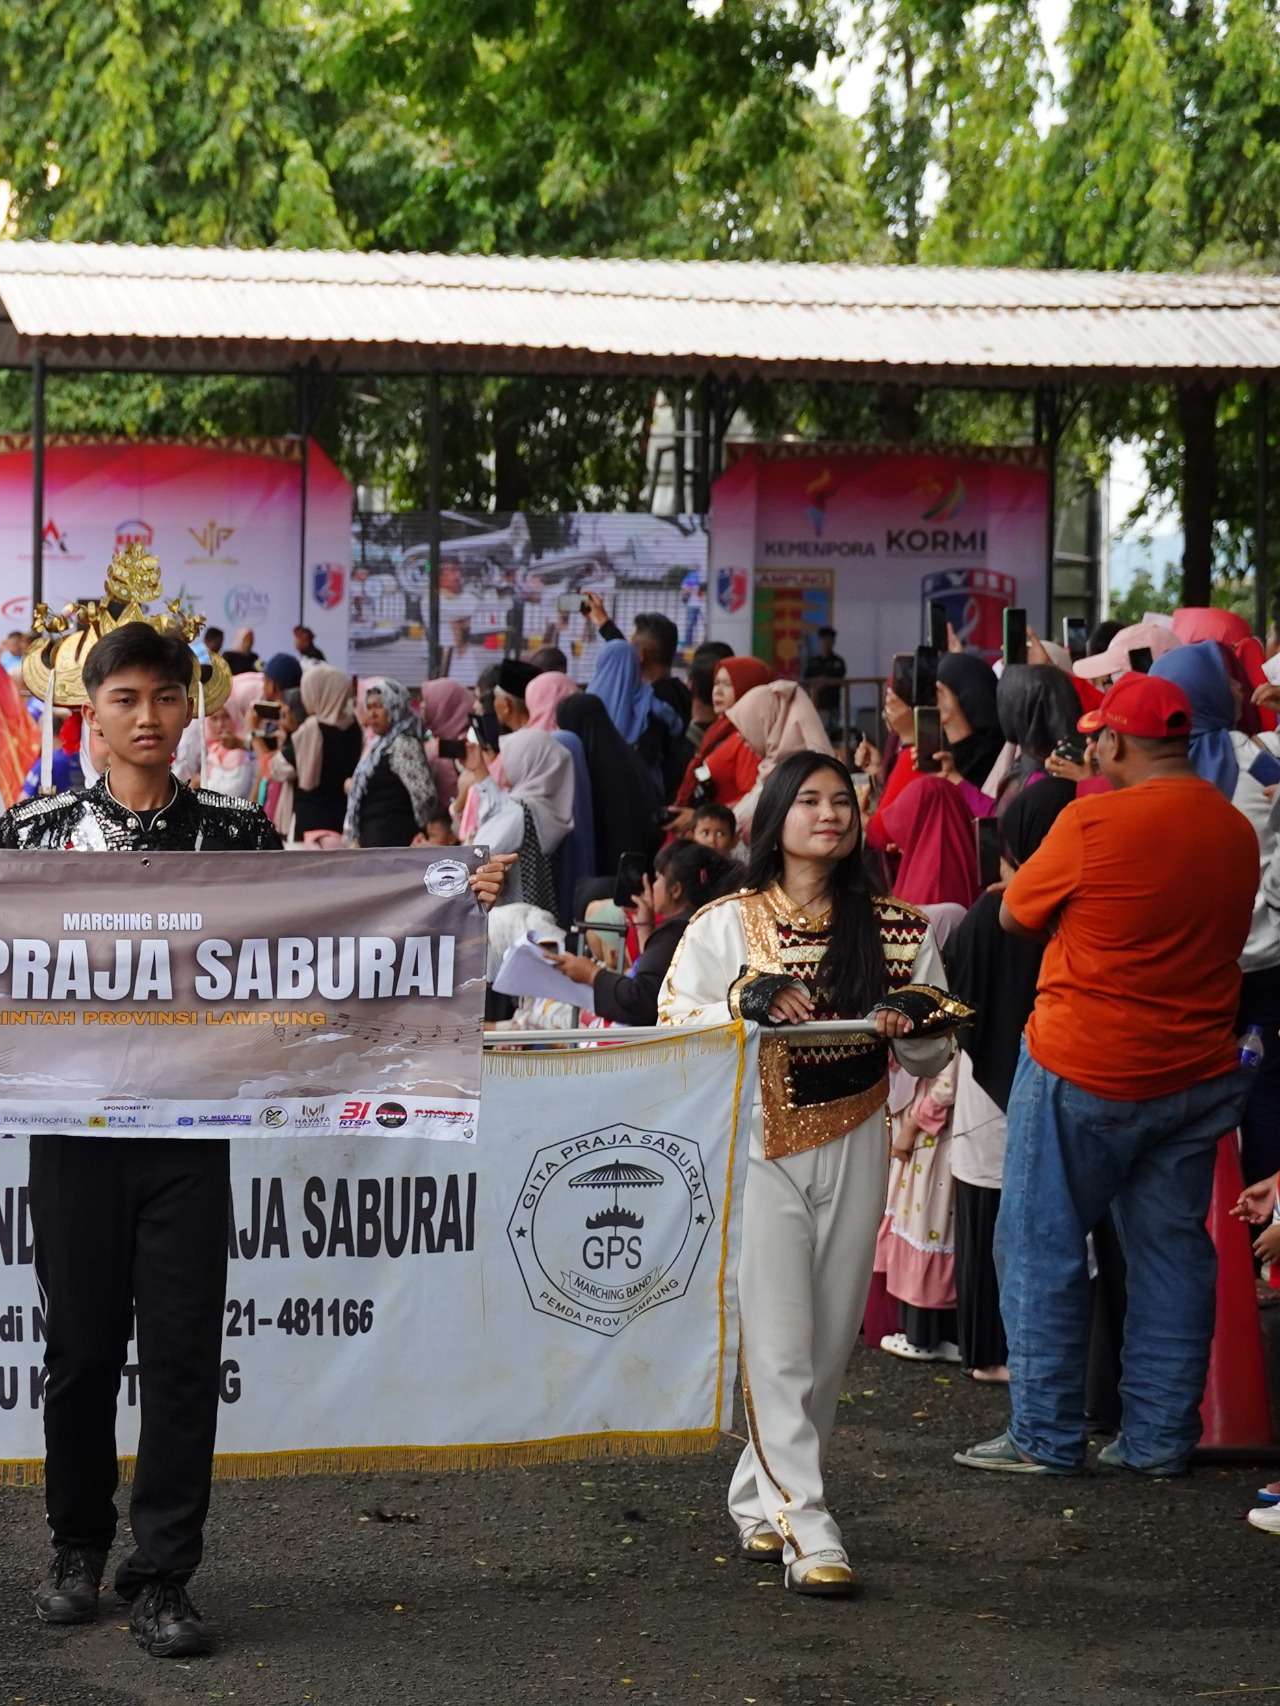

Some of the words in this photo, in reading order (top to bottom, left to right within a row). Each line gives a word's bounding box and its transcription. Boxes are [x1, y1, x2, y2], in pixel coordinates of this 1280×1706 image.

[764, 541, 876, 557] KEMENPORA
[886, 529, 988, 551] KORMI
[63, 913, 152, 931] MARCHING
[157, 912, 202, 931] BAND
[195, 935, 456, 1001] SABURAI
[83, 1011, 197, 1026] PROVINSI
[205, 1011, 327, 1026] LAMPUNG
[3, 1116, 28, 1124] BANK
[31, 1117, 82, 1125] INDONESIA
[339, 1101, 372, 1120] 31
[522, 1161, 559, 1209] GITA
[560, 1133, 632, 1160] PRAJA
[640, 1134, 704, 1201] SABURAI
[301, 1172, 477, 1259] SABURAI
[582, 1235, 642, 1270] GPS
[573, 1276, 625, 1301] MARCHING
[625, 1274, 652, 1299] BAND
[538, 1291, 582, 1321] PEMDA
[585, 1314, 624, 1327] PROV.
[626, 1278, 679, 1320] LAMPUNG
